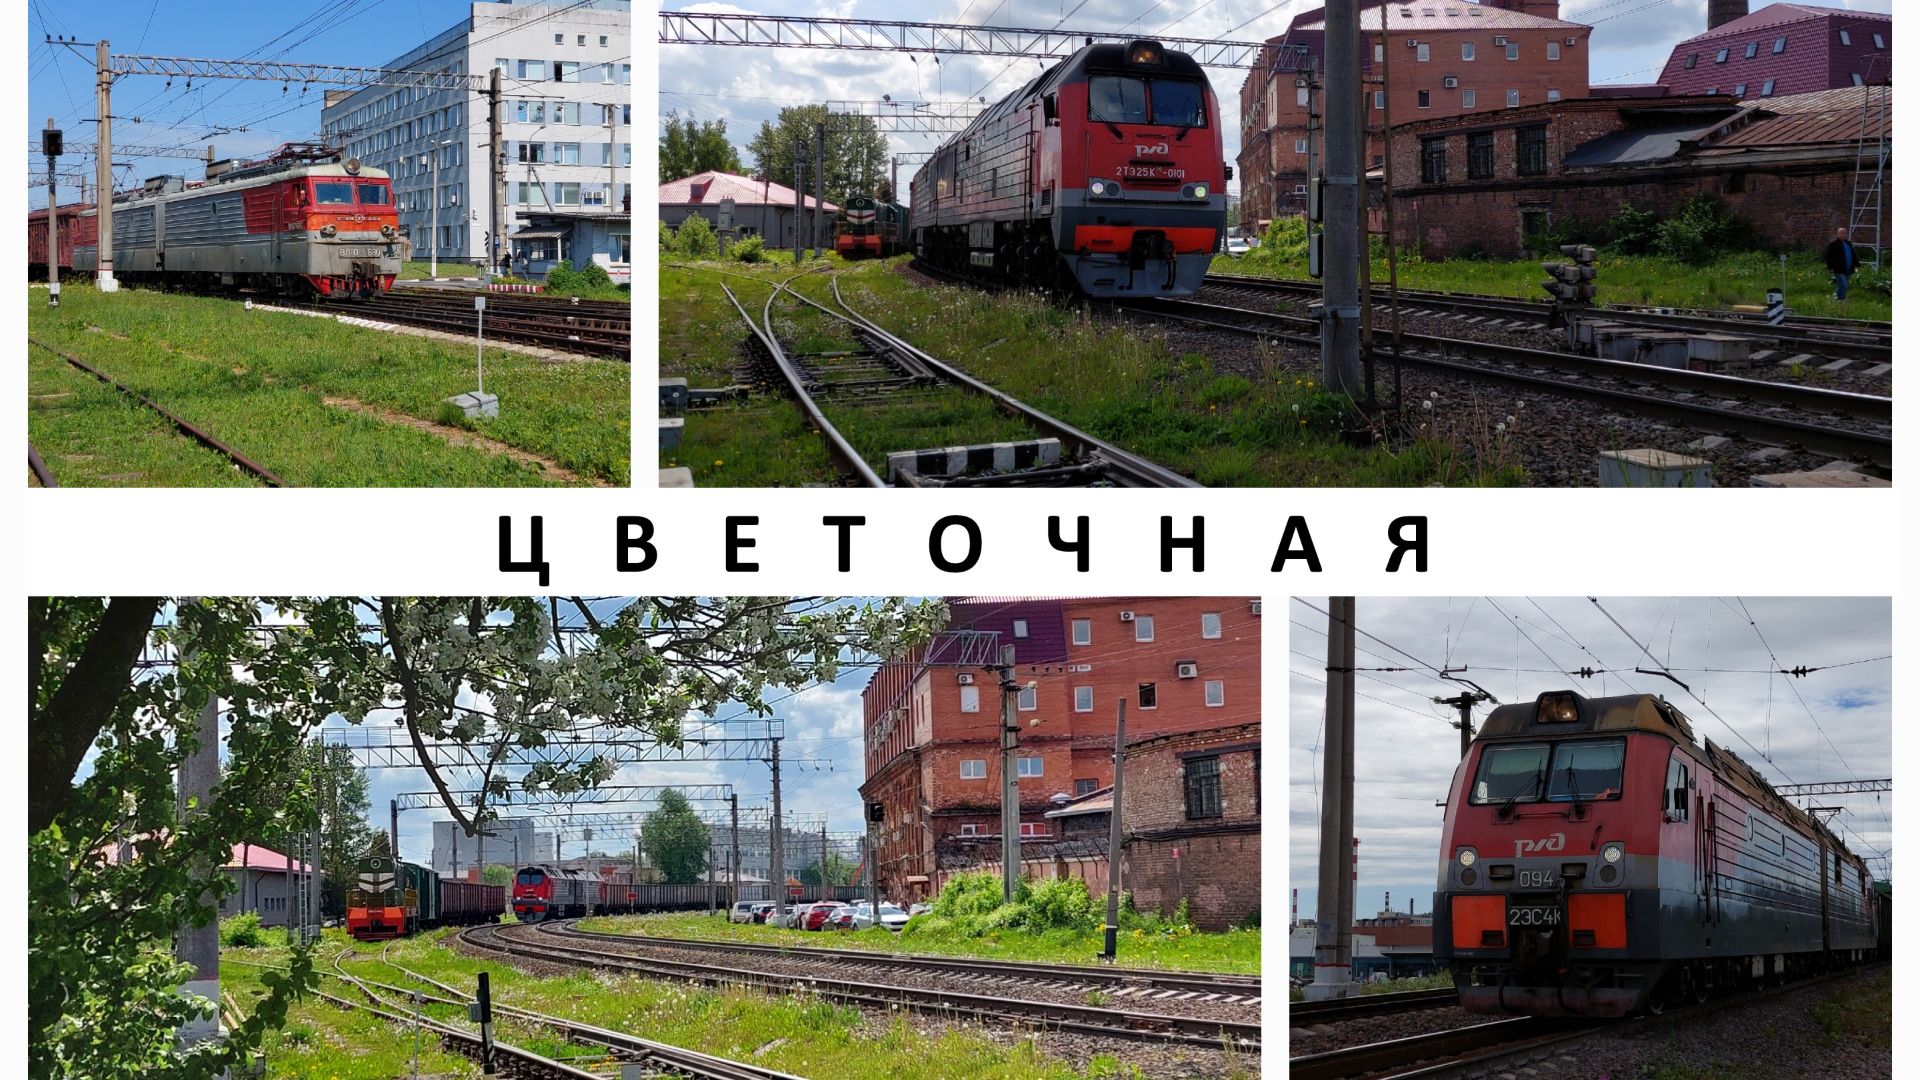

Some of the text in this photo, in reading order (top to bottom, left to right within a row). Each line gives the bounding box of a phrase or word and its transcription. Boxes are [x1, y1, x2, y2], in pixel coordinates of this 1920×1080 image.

[1134, 142, 1169, 158] РЖД
[1768, 294, 1774, 303] 2
[1514, 832, 1566, 858] РЖД
[1519, 870, 1554, 887] 094
